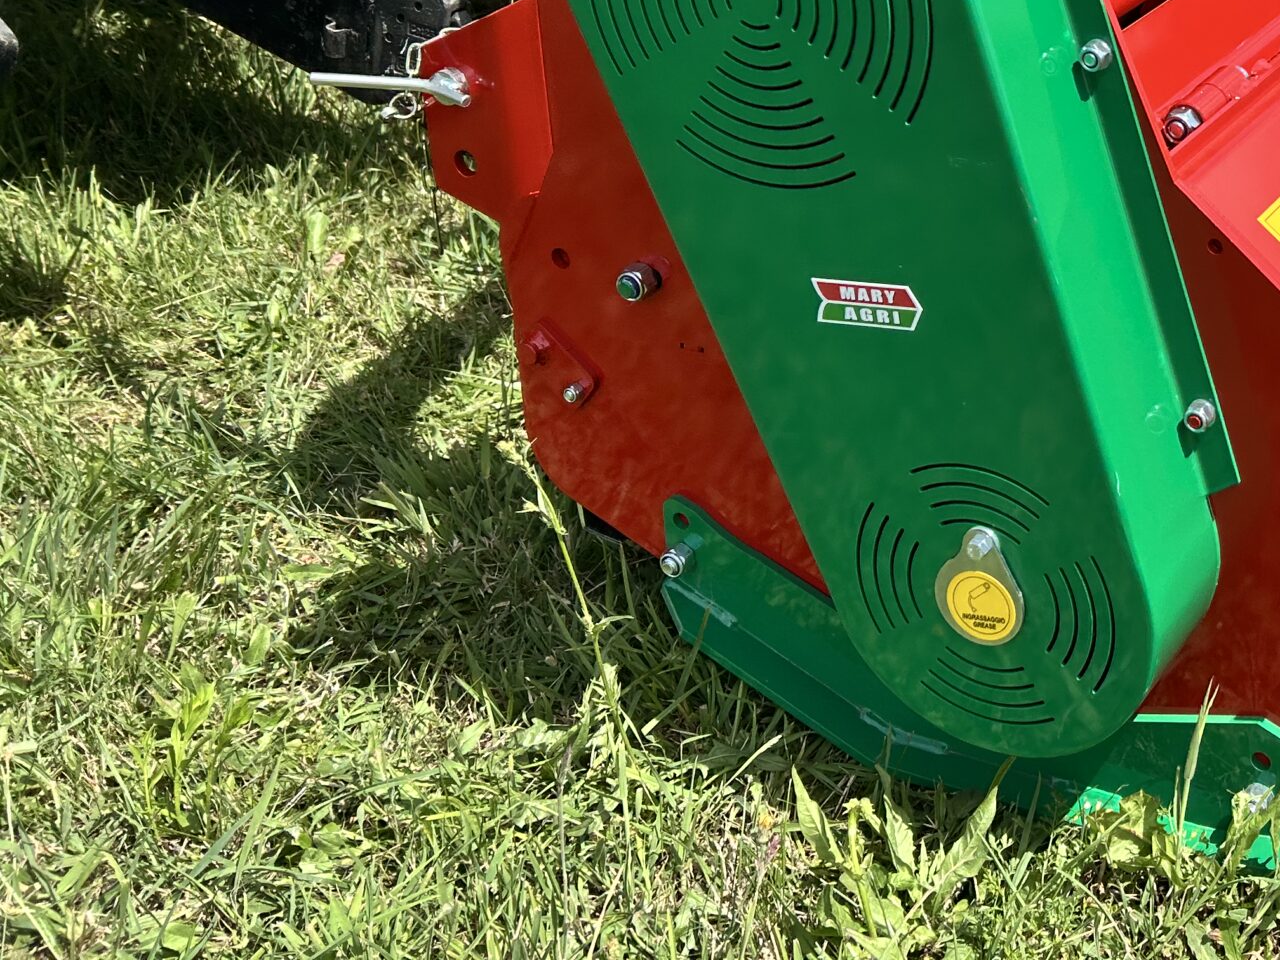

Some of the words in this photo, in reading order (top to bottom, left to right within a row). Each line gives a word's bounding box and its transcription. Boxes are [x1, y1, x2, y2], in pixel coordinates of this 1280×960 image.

[839, 285, 895, 304] MARY
[844, 306, 901, 325] AGRI
[962, 612, 1006, 625] INGRASSAGGIO
[972, 621, 996, 630] GREASE
